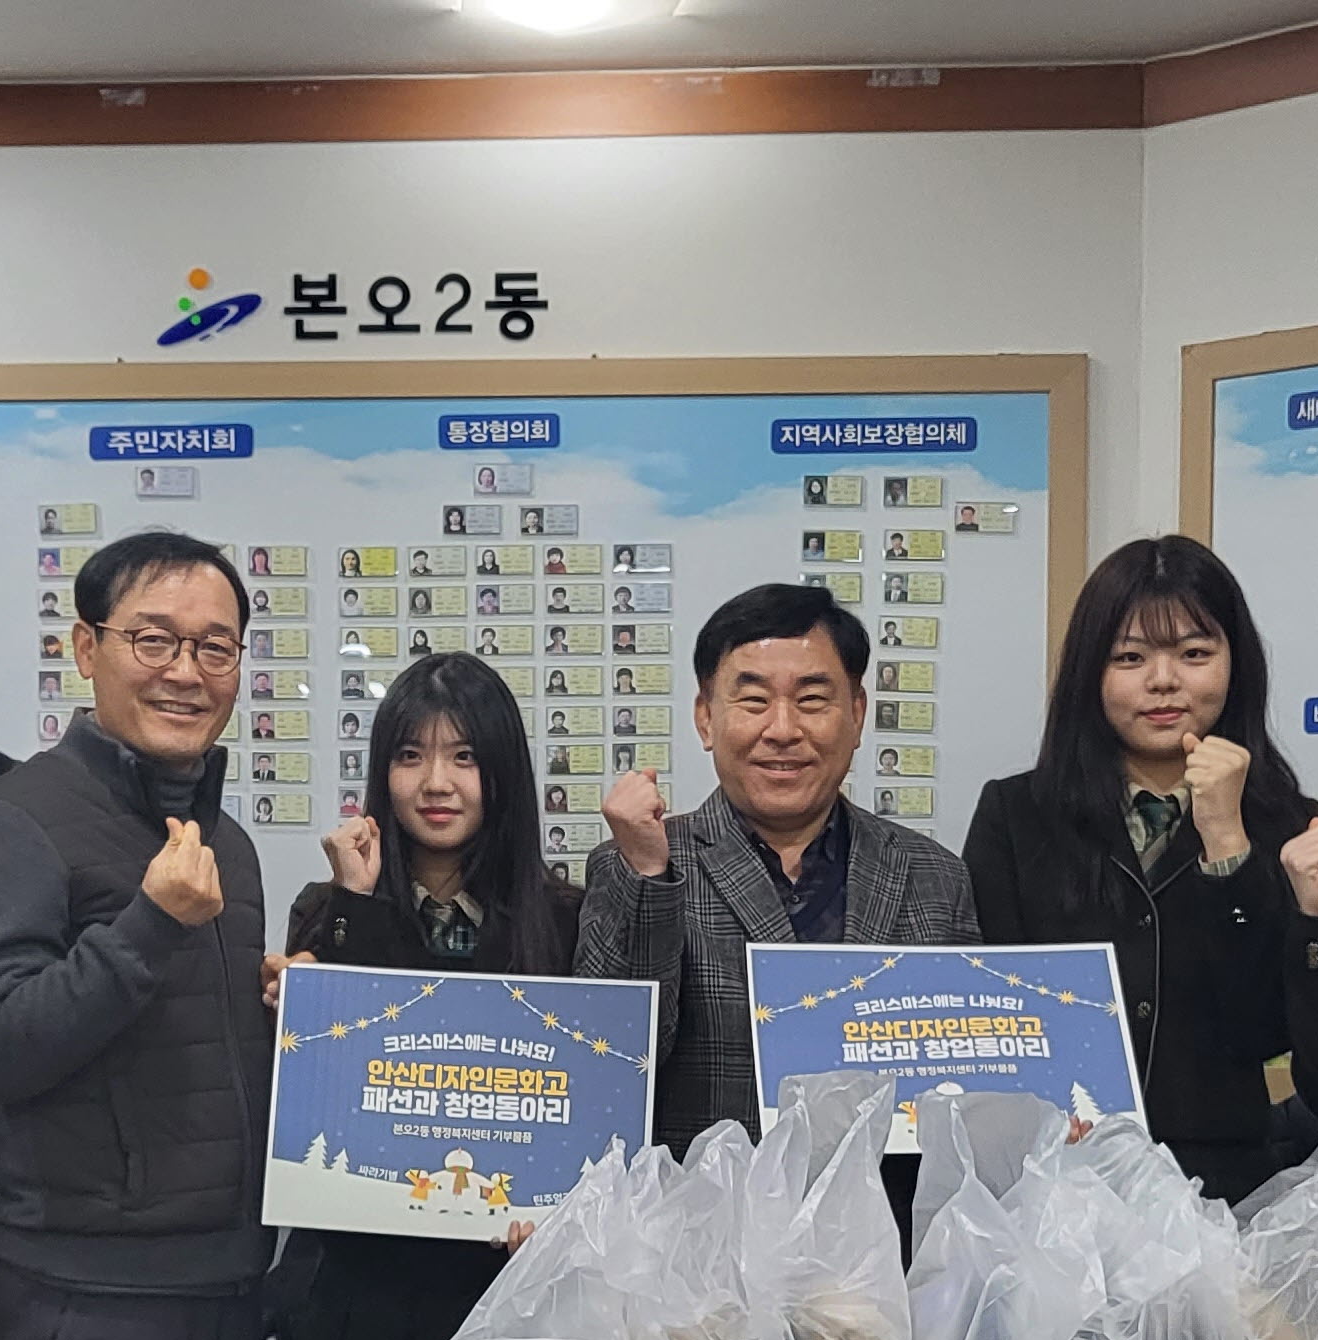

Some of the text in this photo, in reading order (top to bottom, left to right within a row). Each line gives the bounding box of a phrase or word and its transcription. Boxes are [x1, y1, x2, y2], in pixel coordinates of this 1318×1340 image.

[283, 271, 549, 340] 본오2동
[107, 426, 236, 454] 주민자치회
[446, 420, 551, 445] 통장협의회
[780, 422, 967, 447] 지역사회보장협의체
[854, 993, 1023, 1017] 크리스마스에는 나눠요!
[843, 1015, 1044, 1042] 안산디자인문화고
[384, 1032, 556, 1063] 크리스마스에는 나눠요!
[842, 1036, 1050, 1064] 패션과 창업동아리
[367, 1058, 568, 1096] 안산디자인문화고
[361, 1086, 571, 1125] 패션과 창업동아리
[393, 1123, 430, 1139] 본오2동
[431, 1125, 491, 1143] 행정복지센터
